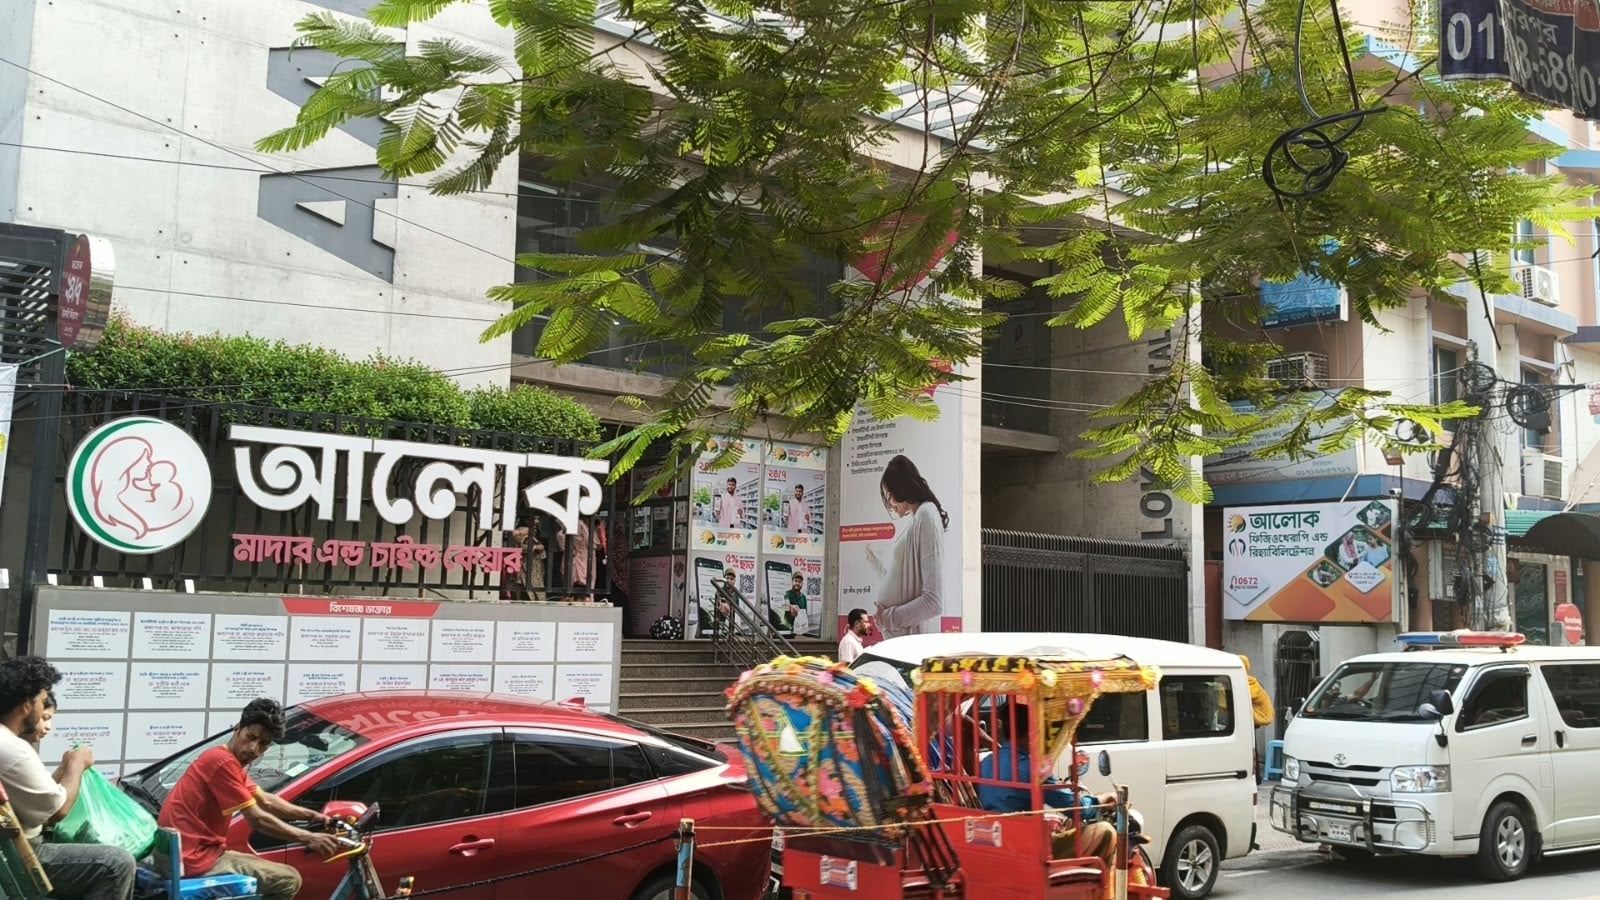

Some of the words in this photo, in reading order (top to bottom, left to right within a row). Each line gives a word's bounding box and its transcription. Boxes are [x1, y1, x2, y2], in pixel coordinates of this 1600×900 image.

[228, 424, 610, 535] আলোক
[1249, 511, 1321, 531] আলোক
[1249, 531, 1309, 545] ফিজিওথেরাপি
[1312, 532, 1328, 543] এন্ড
[232, 533, 315, 565] মাদার
[315, 540, 366, 567] এন্ড
[370, 535, 438, 572] চাইল্ড
[442, 542, 523, 574] কেয়ার
[1235, 577, 1258, 585] 10672
[329, 602, 363, 613] বিশেষজ্ঞ
[365, 605, 392, 614] ডাক্তার
